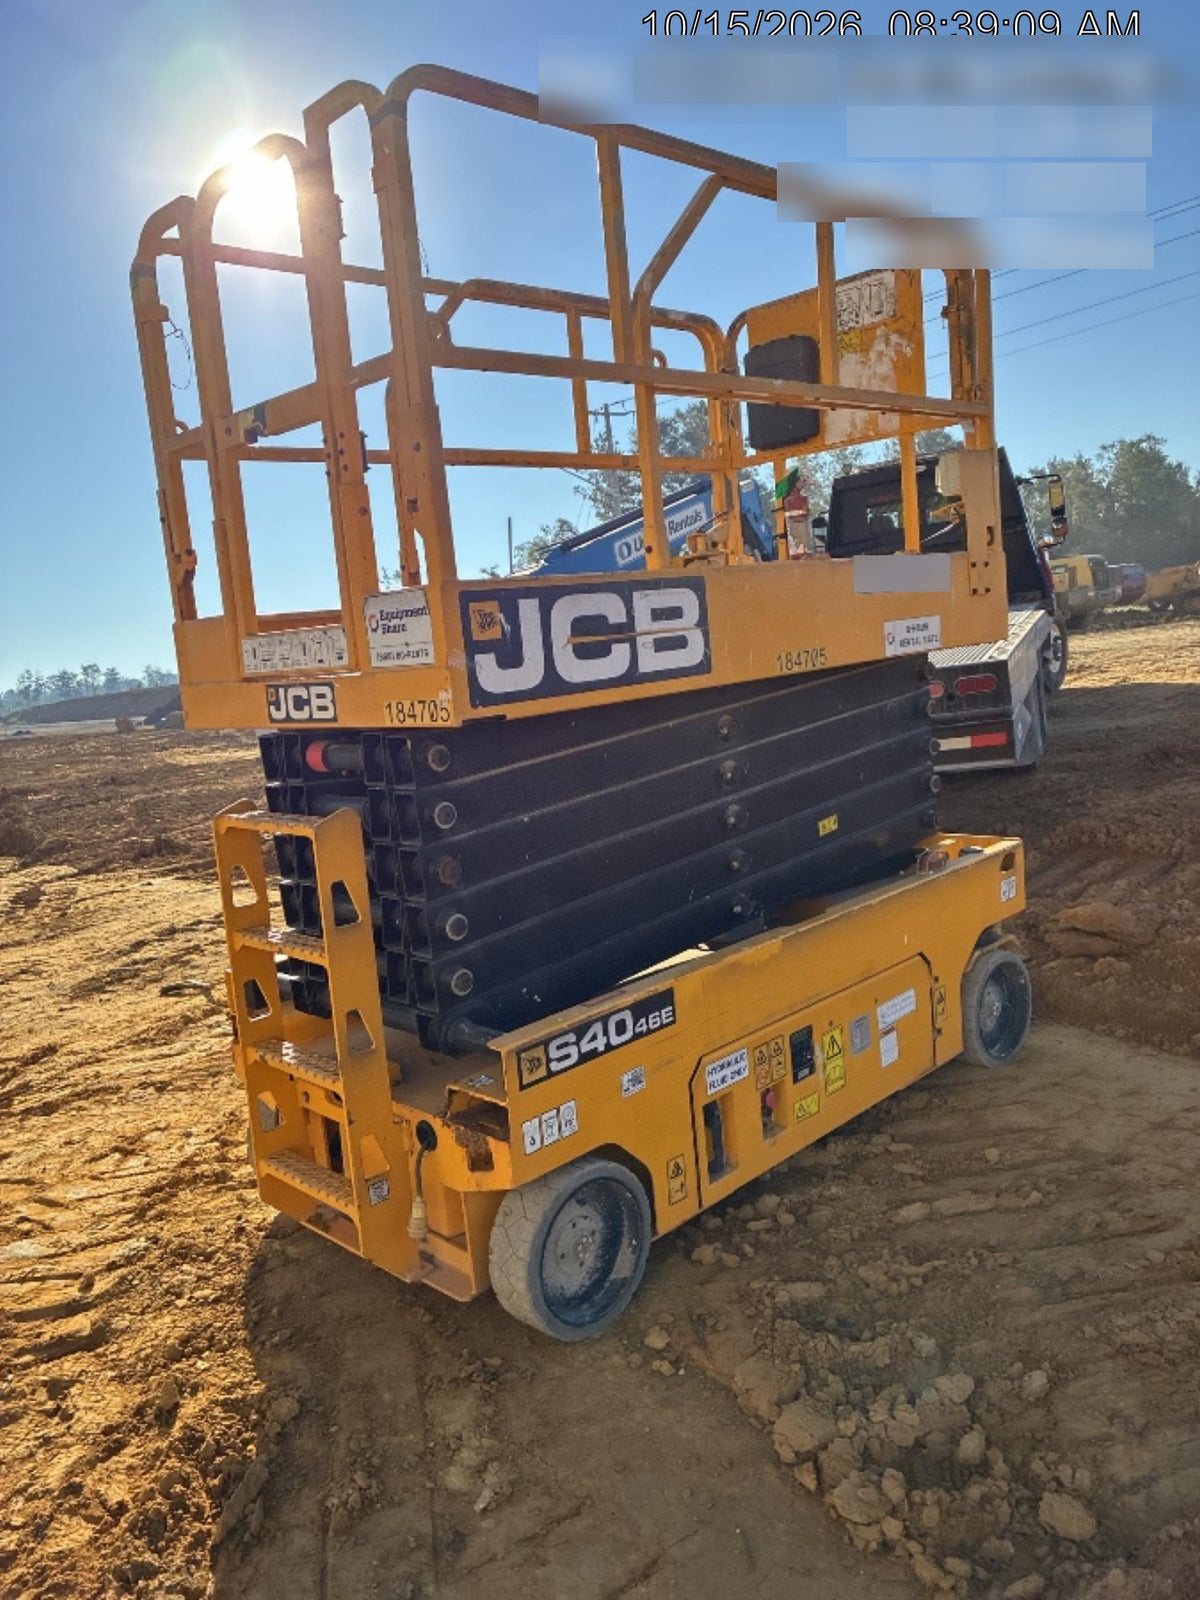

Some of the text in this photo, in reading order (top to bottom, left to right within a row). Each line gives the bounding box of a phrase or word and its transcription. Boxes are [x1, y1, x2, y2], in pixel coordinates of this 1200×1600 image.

[667, 508, 703, 536] Rentals
[473, 587, 706, 695] JCB
[776, 647, 828, 672] 184705
[269, 685, 335, 720] JCB
[385, 699, 451, 724] 184705
